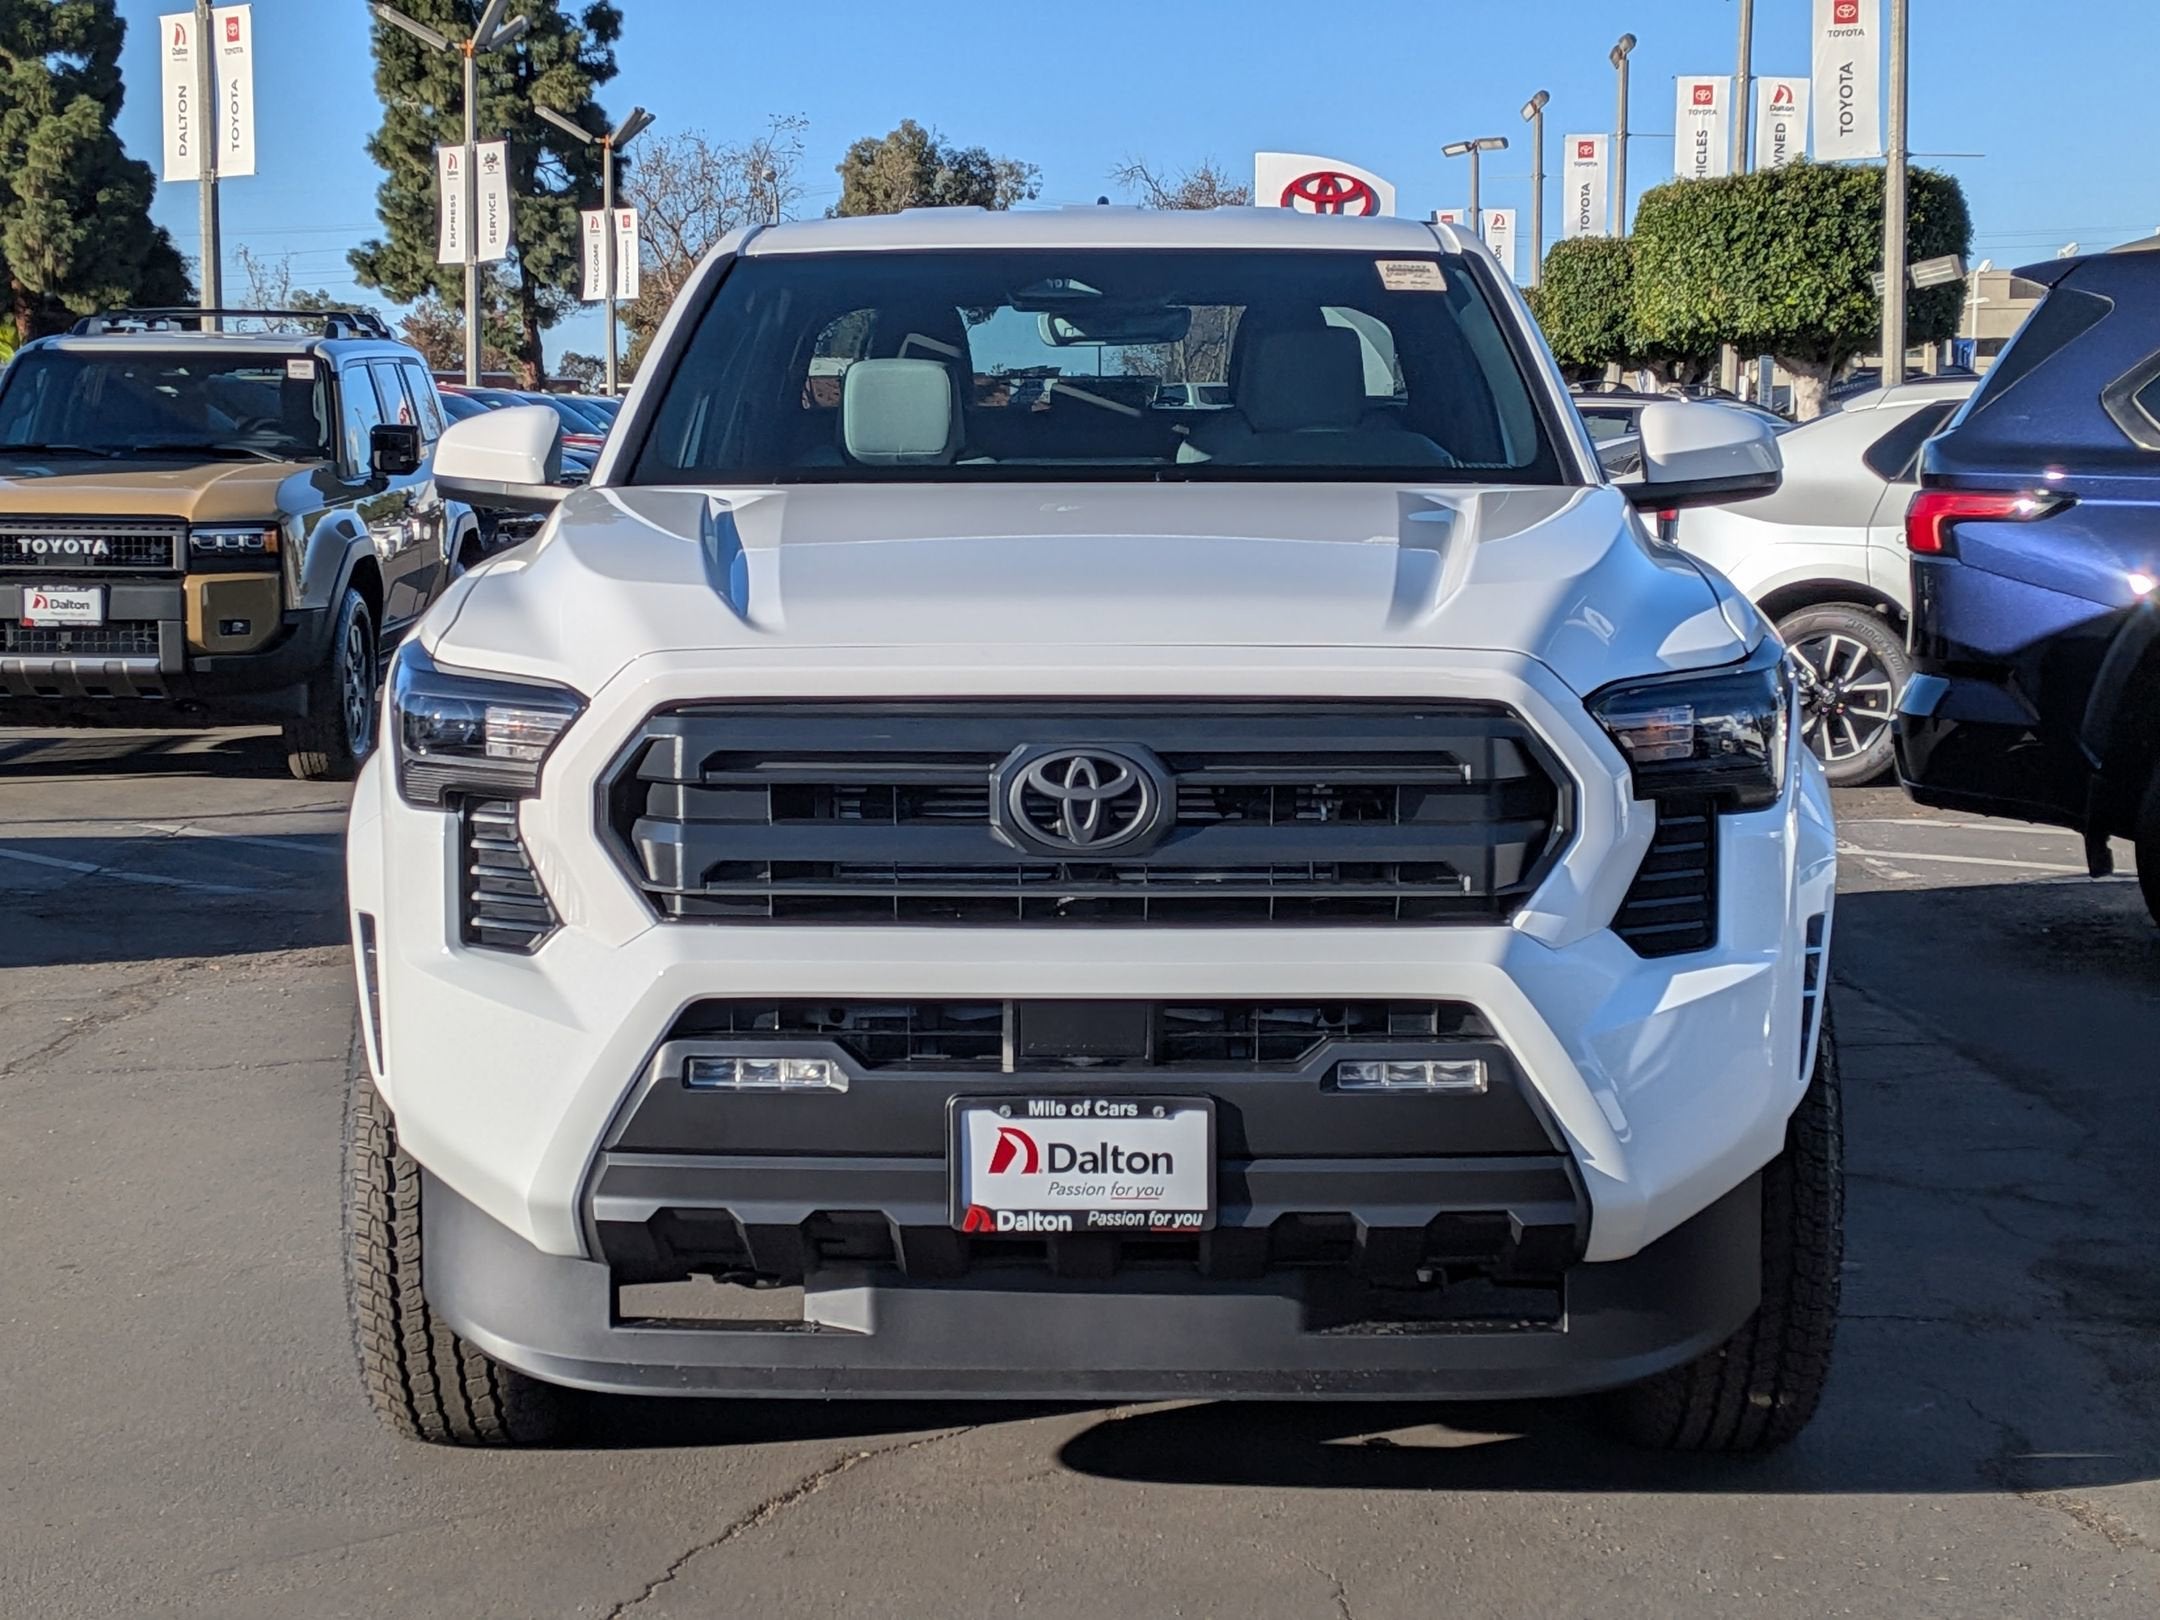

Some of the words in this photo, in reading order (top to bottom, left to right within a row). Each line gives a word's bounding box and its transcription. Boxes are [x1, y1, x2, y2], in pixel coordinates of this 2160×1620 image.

[1828, 28, 1865, 38] TOYOTA
[1769, 104, 1795, 112] Dalton
[1839, 61, 1853, 137] TOYOTA
[178, 85, 188, 156] DALTON
[231, 79, 240, 152] TOYOTA
[1580, 182, 1590, 232] TOYOTA
[489, 193, 497, 244] SERVICE
[17, 538, 109, 555] TOYOTA
[50, 599, 90, 610] Dalton
[1028, 1100, 1066, 1117] Mile
[1071, 1100, 1090, 1116] of
[1095, 1100, 1138, 1117] Cars
[1048, 1142, 1174, 1175] Dalton
[1048, 1181, 1105, 1197] Passion
[1111, 1181, 1132, 1197] for
[1135, 1187, 1164, 1199] you
[997, 1211, 1072, 1232] Dalton
[1087, 1211, 1144, 1227] Passion
[1149, 1211, 1171, 1227] for
[1173, 1212, 1203, 1229] you
